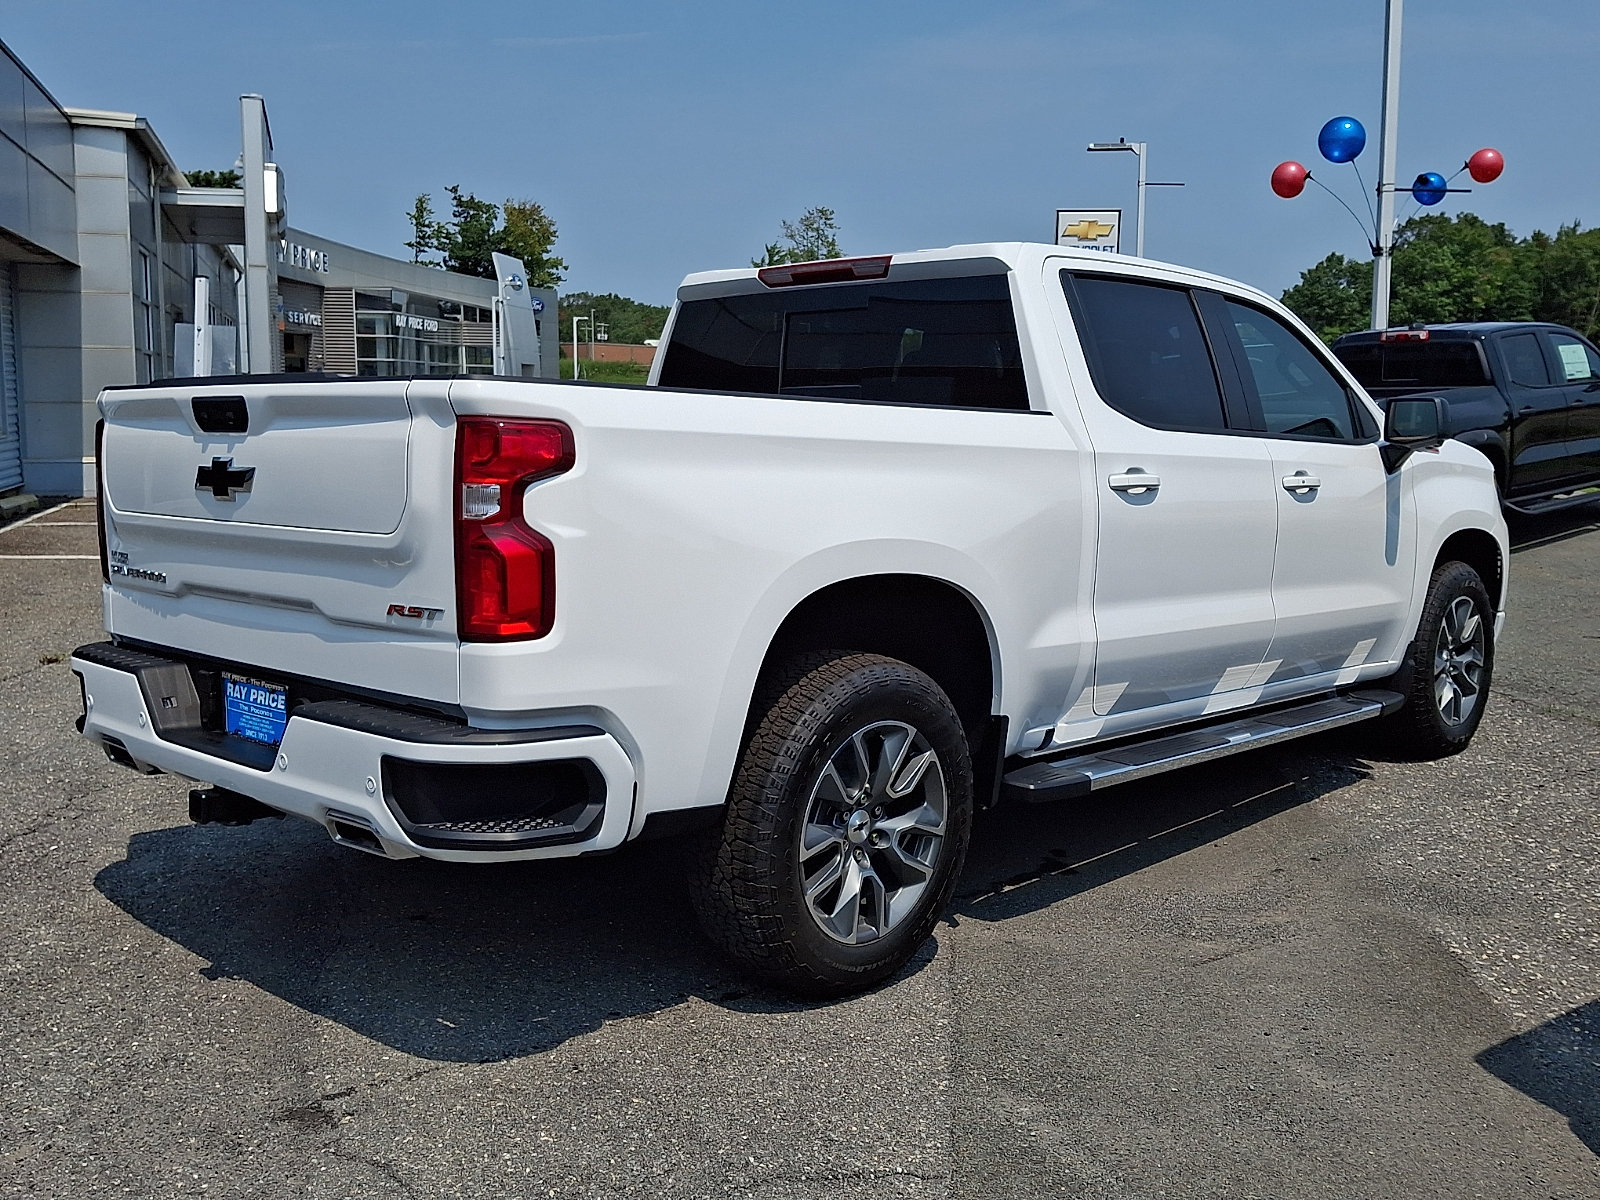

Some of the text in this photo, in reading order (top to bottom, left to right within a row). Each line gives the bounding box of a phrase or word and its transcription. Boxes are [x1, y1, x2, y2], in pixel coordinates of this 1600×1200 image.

[291, 243, 329, 274] PRICE
[288, 311, 322, 326] SERVICE
[395, 315, 439, 332] RAY PRICE FORD
[386, 603, 445, 621] RST
[231, 674, 248, 683] PRICE
[227, 683, 285, 709] RAY PRICE
